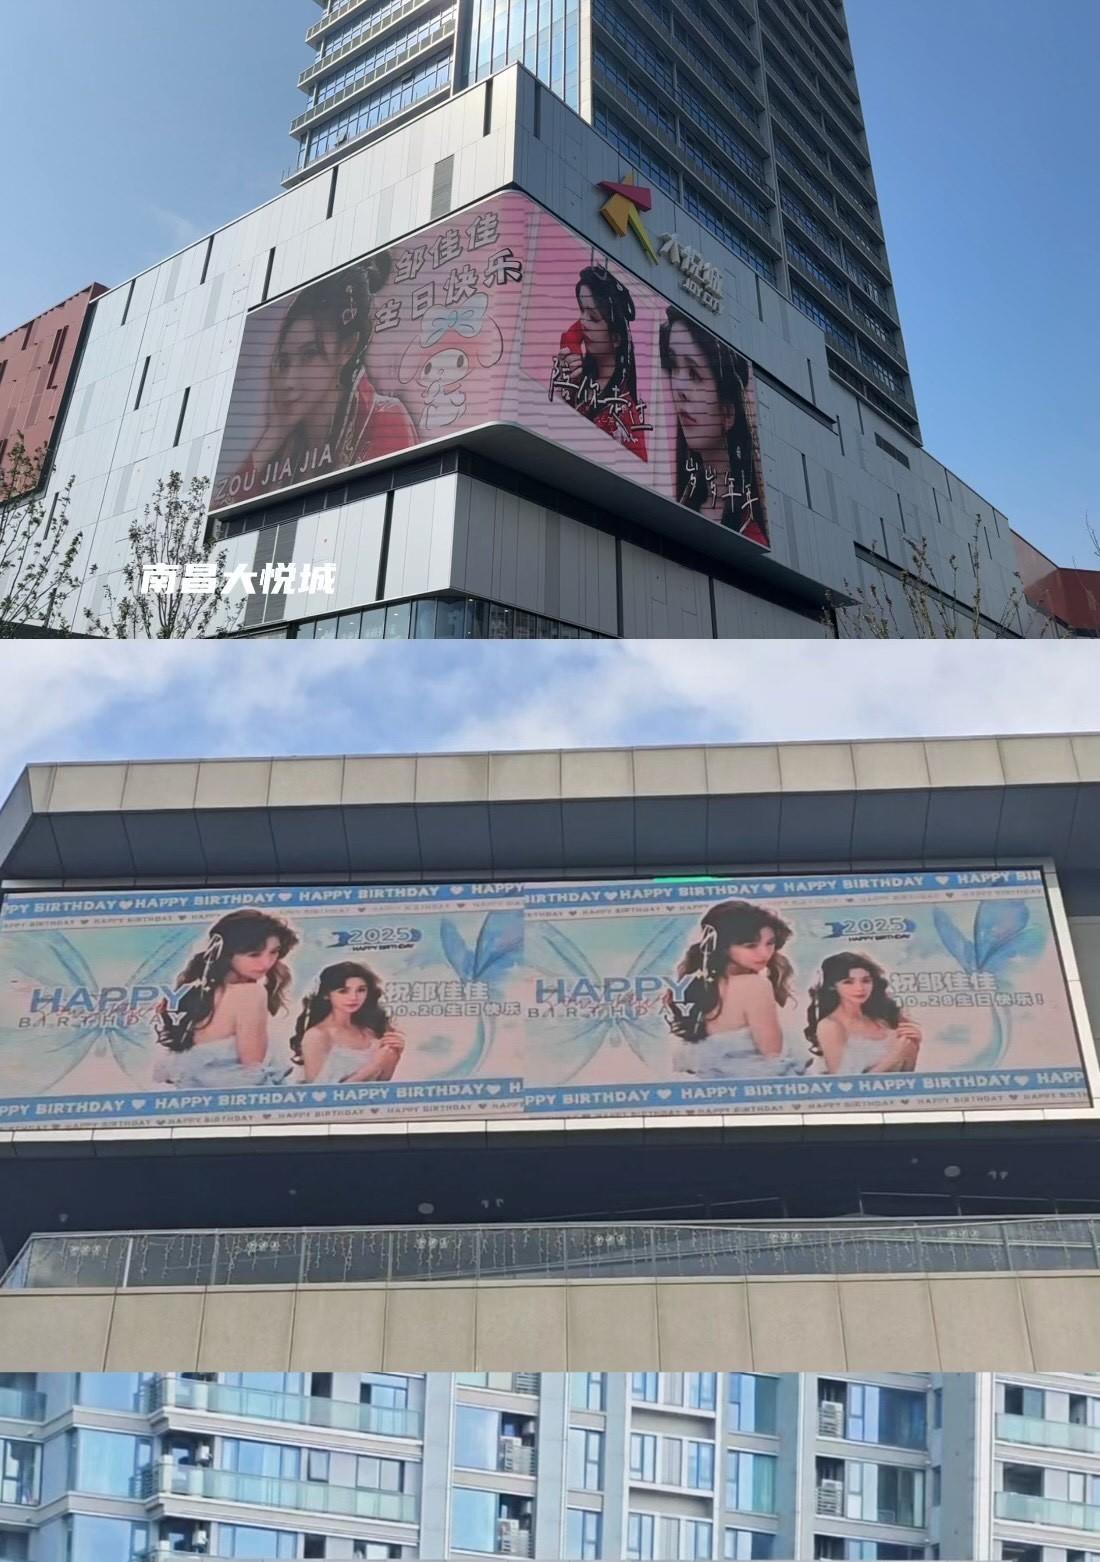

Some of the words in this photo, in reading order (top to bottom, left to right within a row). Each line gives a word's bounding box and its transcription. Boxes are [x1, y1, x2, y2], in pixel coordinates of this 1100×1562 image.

[394, 211, 500, 285] 邹佳佳
[374, 247, 523, 333] 生日快乐
[216, 474, 254, 500] ZOU
[262, 456, 293, 486] JIA
[300, 444, 333, 474] JIA
[784, 879, 837, 893] HAPPY
[842, 875, 924, 890] BIRTHDAY
[957, 870, 1013, 884] HAPPY
[299, 889, 352, 901] HAPPY
[358, 885, 440, 899] BIRTHDAY
[471, 882, 524, 895] HAPPY
[620, 887, 673, 900] HAPPY
[678, 883, 759, 897] BIRTHDAY
[34, 899, 116, 914] BIRTHDAY
[135, 894, 191, 909] HAPPY
[194, 891, 275, 906] BIRTHDAY
[841, 917, 907, 934] 2025
[349, 927, 413, 943] 2025
[384, 981, 489, 1002] 祝邹佳佳
[536, 976, 696, 1005] HAPPY
[891, 972, 997, 993] 祝邹佳佳
[30, 982, 193, 1014] HAPPY
[859, 1077, 915, 1091] HAPPY
[923, 1073, 1011, 1089] BIRTHDAY
[1036, 1072, 1084, 1085] HAPP
[333, 1087, 390, 1101] HAPPY
[396, 1083, 489, 1098] BIRTHDAY
[562, 1089, 651, 1105] BIRTHDAY
[681, 1085, 738, 1099] HAPPY
[744, 1081, 833, 1097] BIRTHDAY
[35, 1099, 126, 1116] BIRTHDAY
[155, 1095, 215, 1110] HAPPY
[218, 1090, 307, 1106] BIRTHDAY
